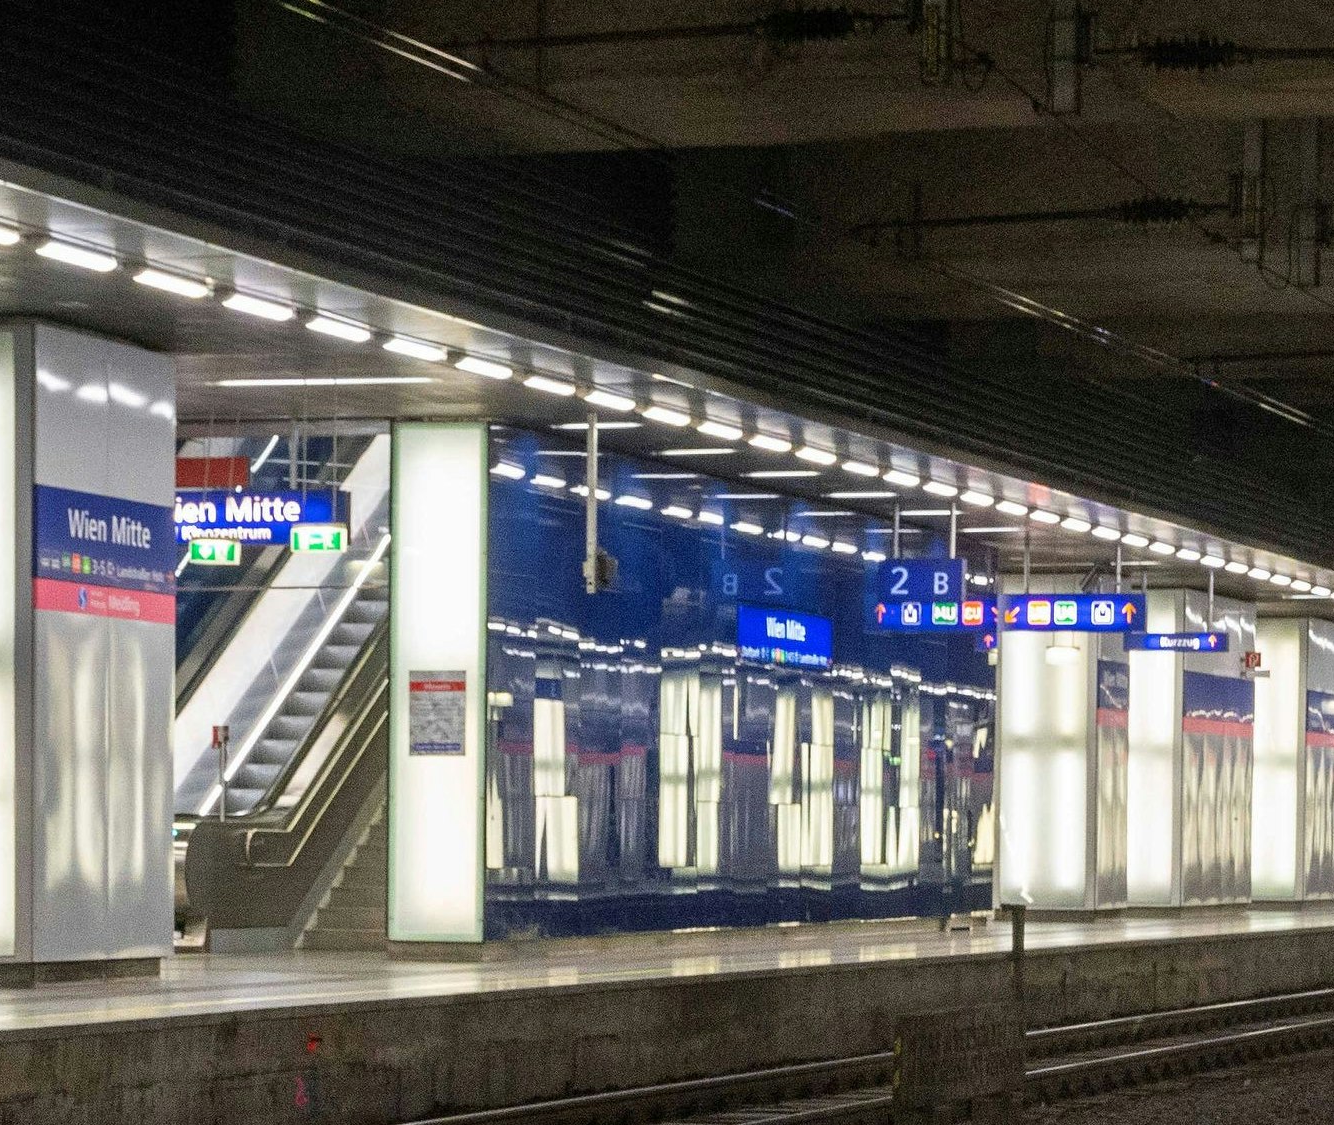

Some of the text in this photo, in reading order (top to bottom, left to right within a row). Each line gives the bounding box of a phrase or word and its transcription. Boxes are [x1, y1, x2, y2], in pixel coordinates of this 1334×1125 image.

[174, 495, 301, 524] ien Mitte
[68, 507, 151, 549] Wien Mitte
[890, 566, 949, 595] 2 B
